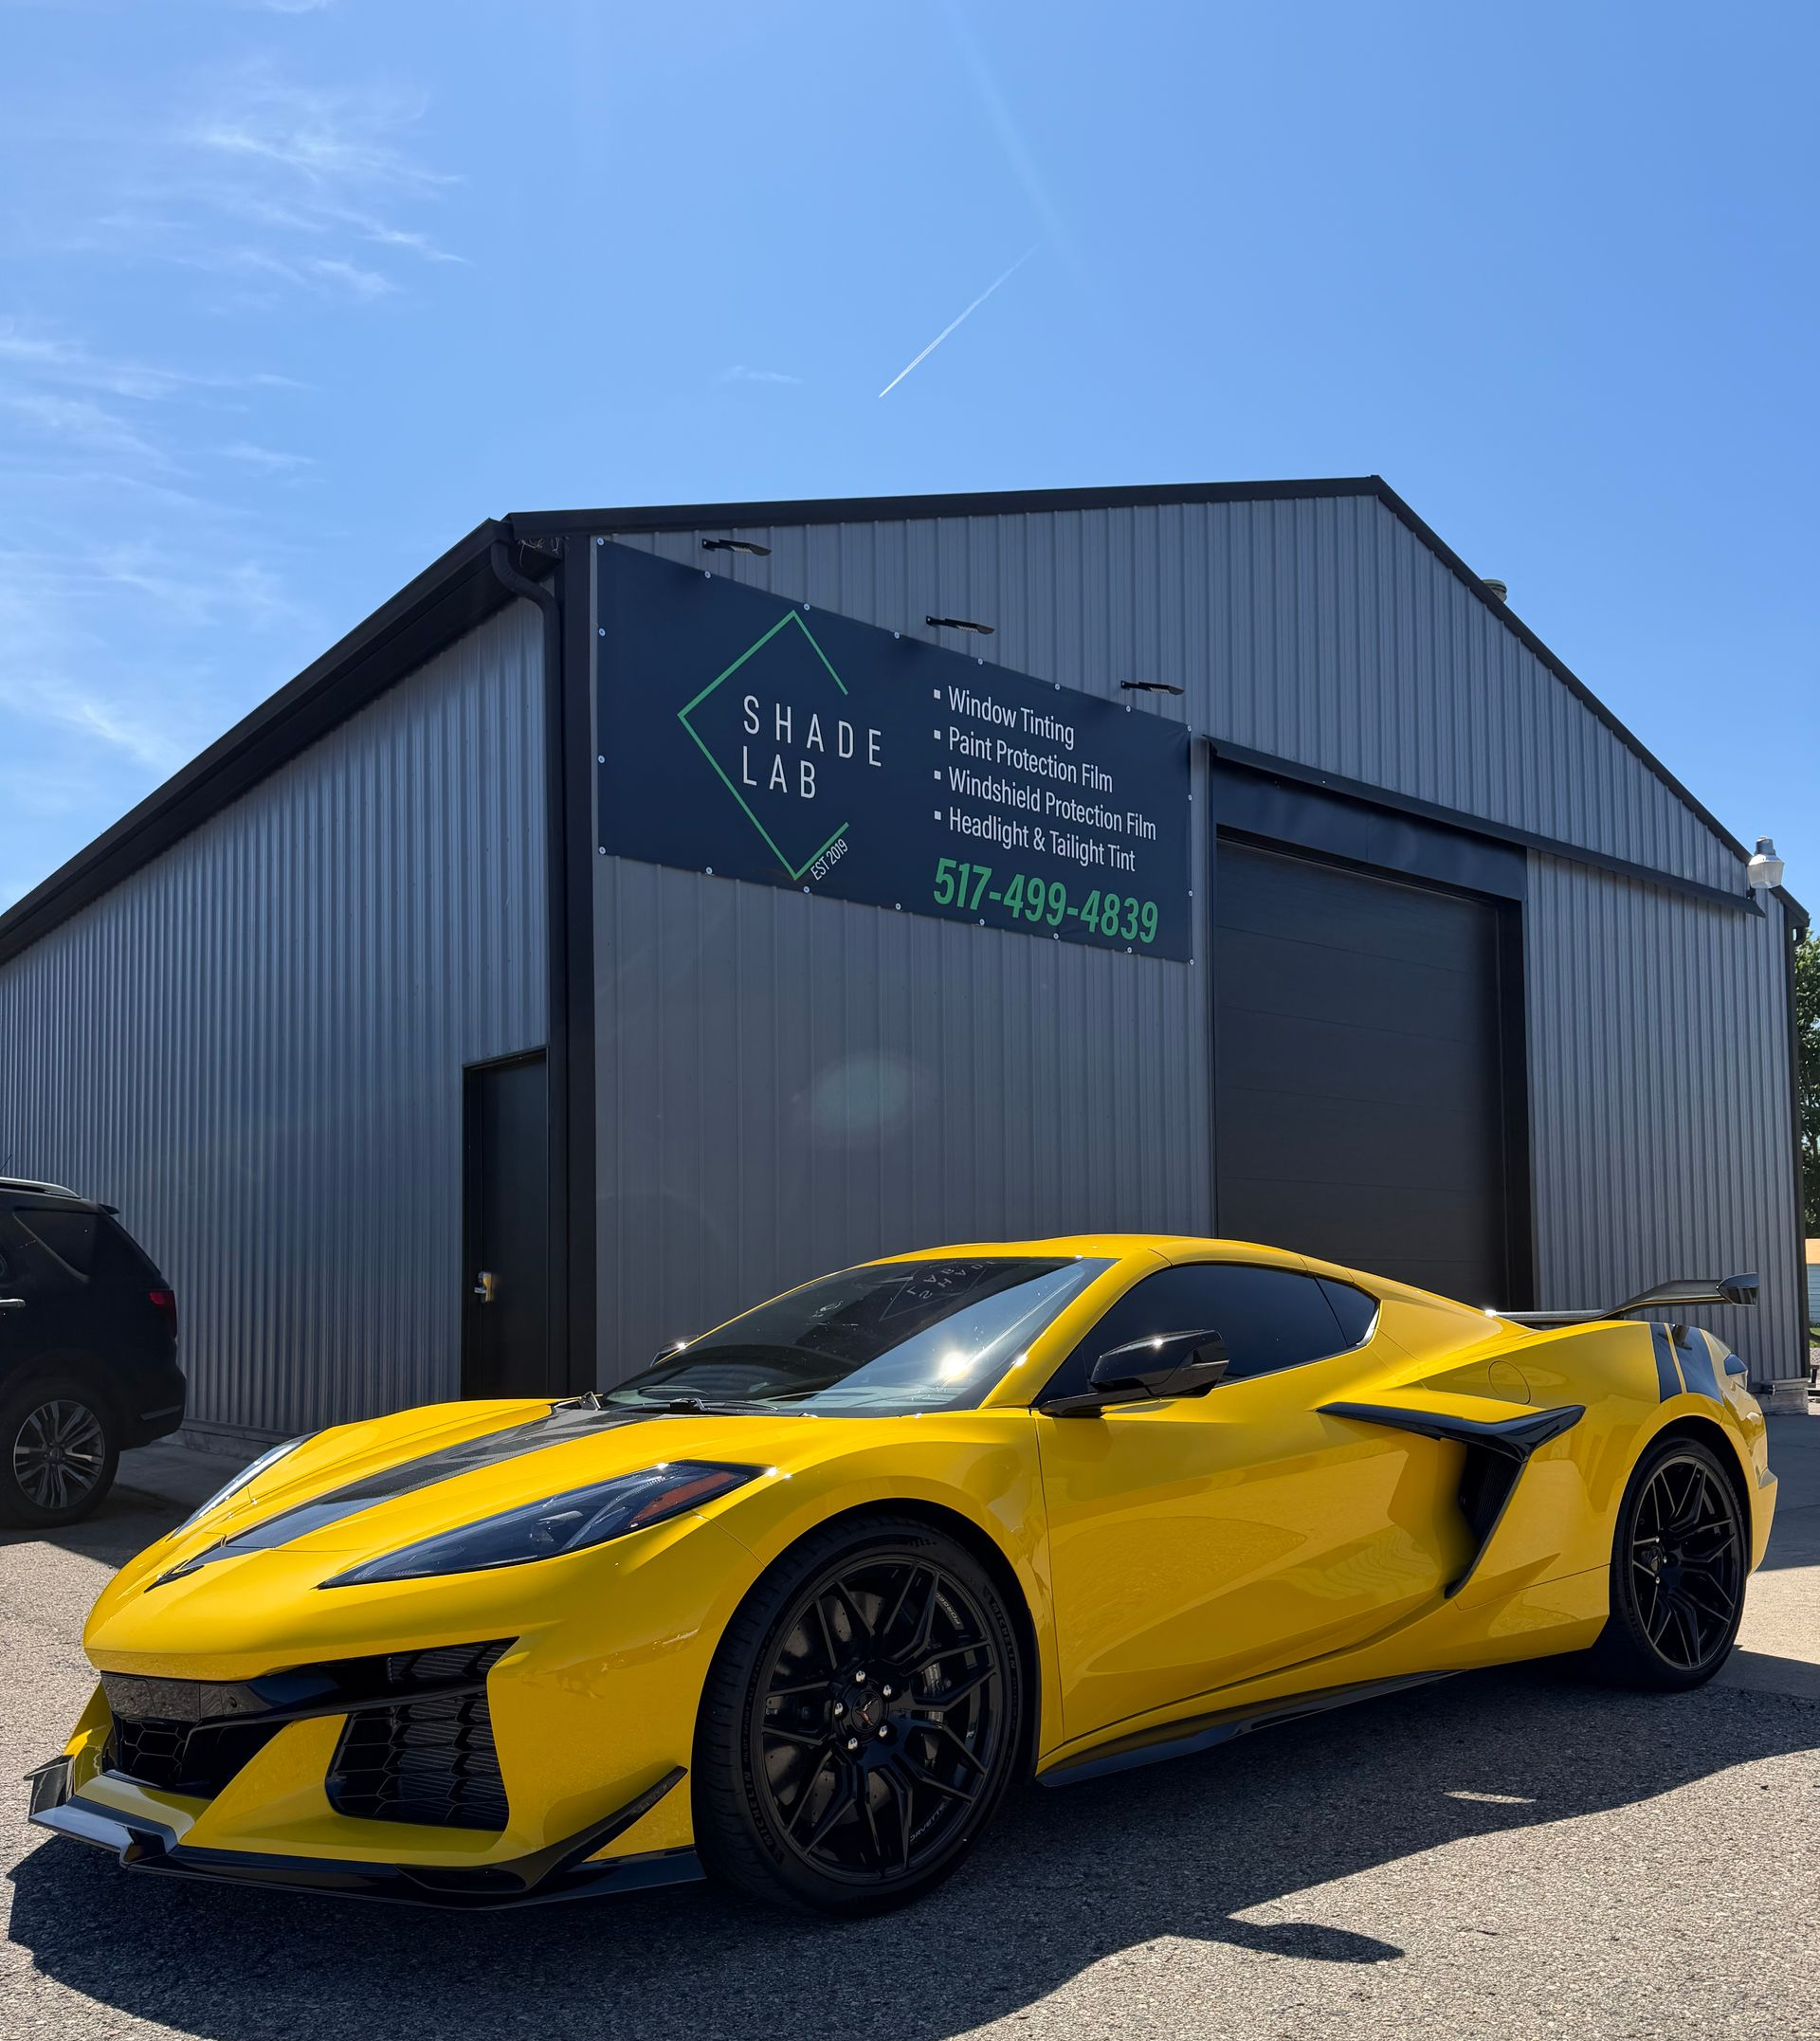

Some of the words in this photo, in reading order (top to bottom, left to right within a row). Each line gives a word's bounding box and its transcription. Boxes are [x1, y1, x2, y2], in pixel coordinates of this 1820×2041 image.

[742, 695, 883, 768] SHADE
[948, 684, 1017, 729] Window
[1020, 706, 1075, 751] Tinting
[742, 745, 816, 800] LAB
[949, 726, 992, 761] Paint
[996, 739, 1077, 785] Protection
[1082, 762, 1113, 793] Film
[948, 765, 1041, 812] Windshield
[1046, 791, 1122, 833] Protection
[1126, 811, 1156, 841] Film
[810, 856, 829, 881] EST
[826, 838, 848, 866] 2019
[949, 806, 1029, 850] Headlight
[1033, 827, 1046, 852] &
[1049, 829, 1105, 867] Tailight
[1108, 843, 1136, 872] Tint
[933, 857, 1159, 944] 517-499-4839
[990, 1602, 1017, 1669] MICHELIN
[742, 1771, 775, 1848] MICHELIN
